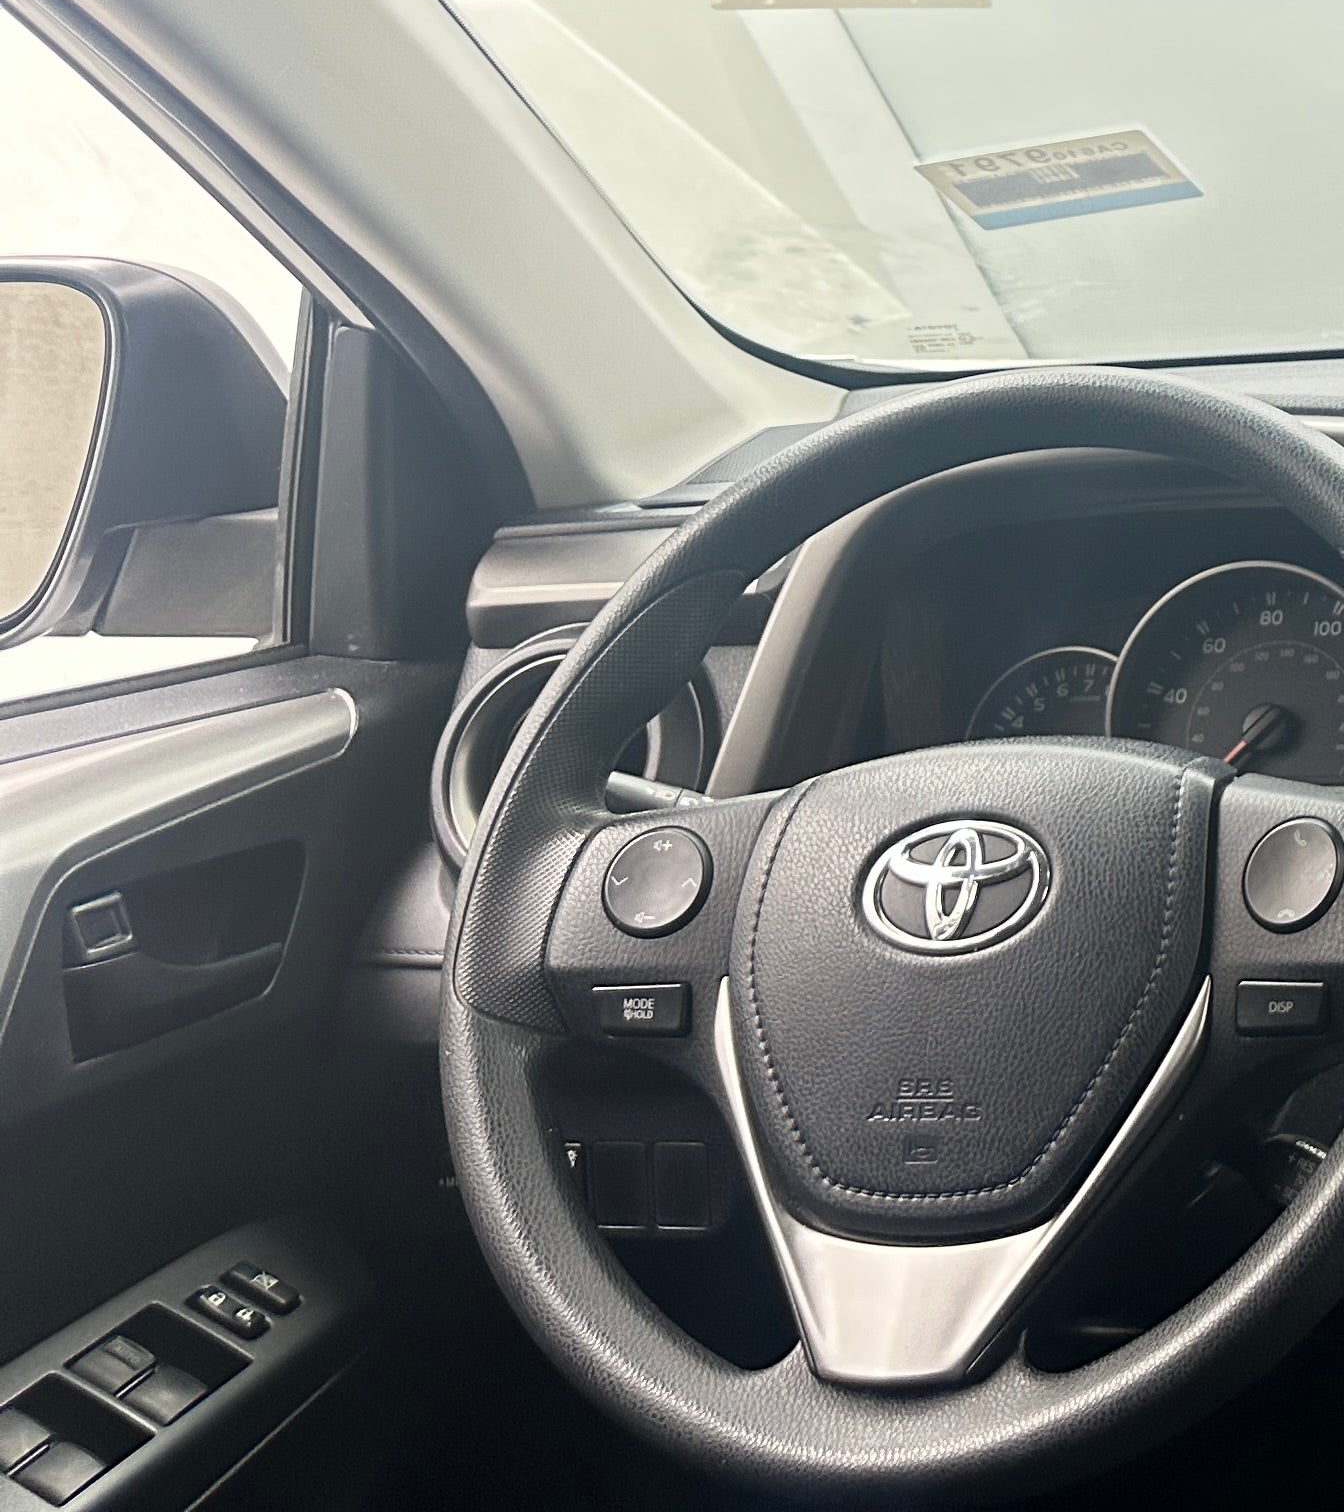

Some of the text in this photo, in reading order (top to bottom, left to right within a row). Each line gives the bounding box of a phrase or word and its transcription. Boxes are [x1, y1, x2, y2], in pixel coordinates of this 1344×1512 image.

[1259, 609, 1285, 626] 80
[1313, 620, 1342, 637] 100
[1202, 637, 1227, 654] 60
[1056, 682, 1069, 697] 6
[1082, 679, 1095, 693] 7
[1163, 687, 1188, 705] 40
[1033, 697, 1046, 712] 5
[1011, 715, 1024, 729] 4
[623, 997, 656, 1010] MODE
[1268, 1000, 1294, 1014] DISP
[630, 1009, 654, 1020] HOLD
[897, 1078, 955, 1097] SRS
[866, 1101, 982, 1122] AIRBAG
